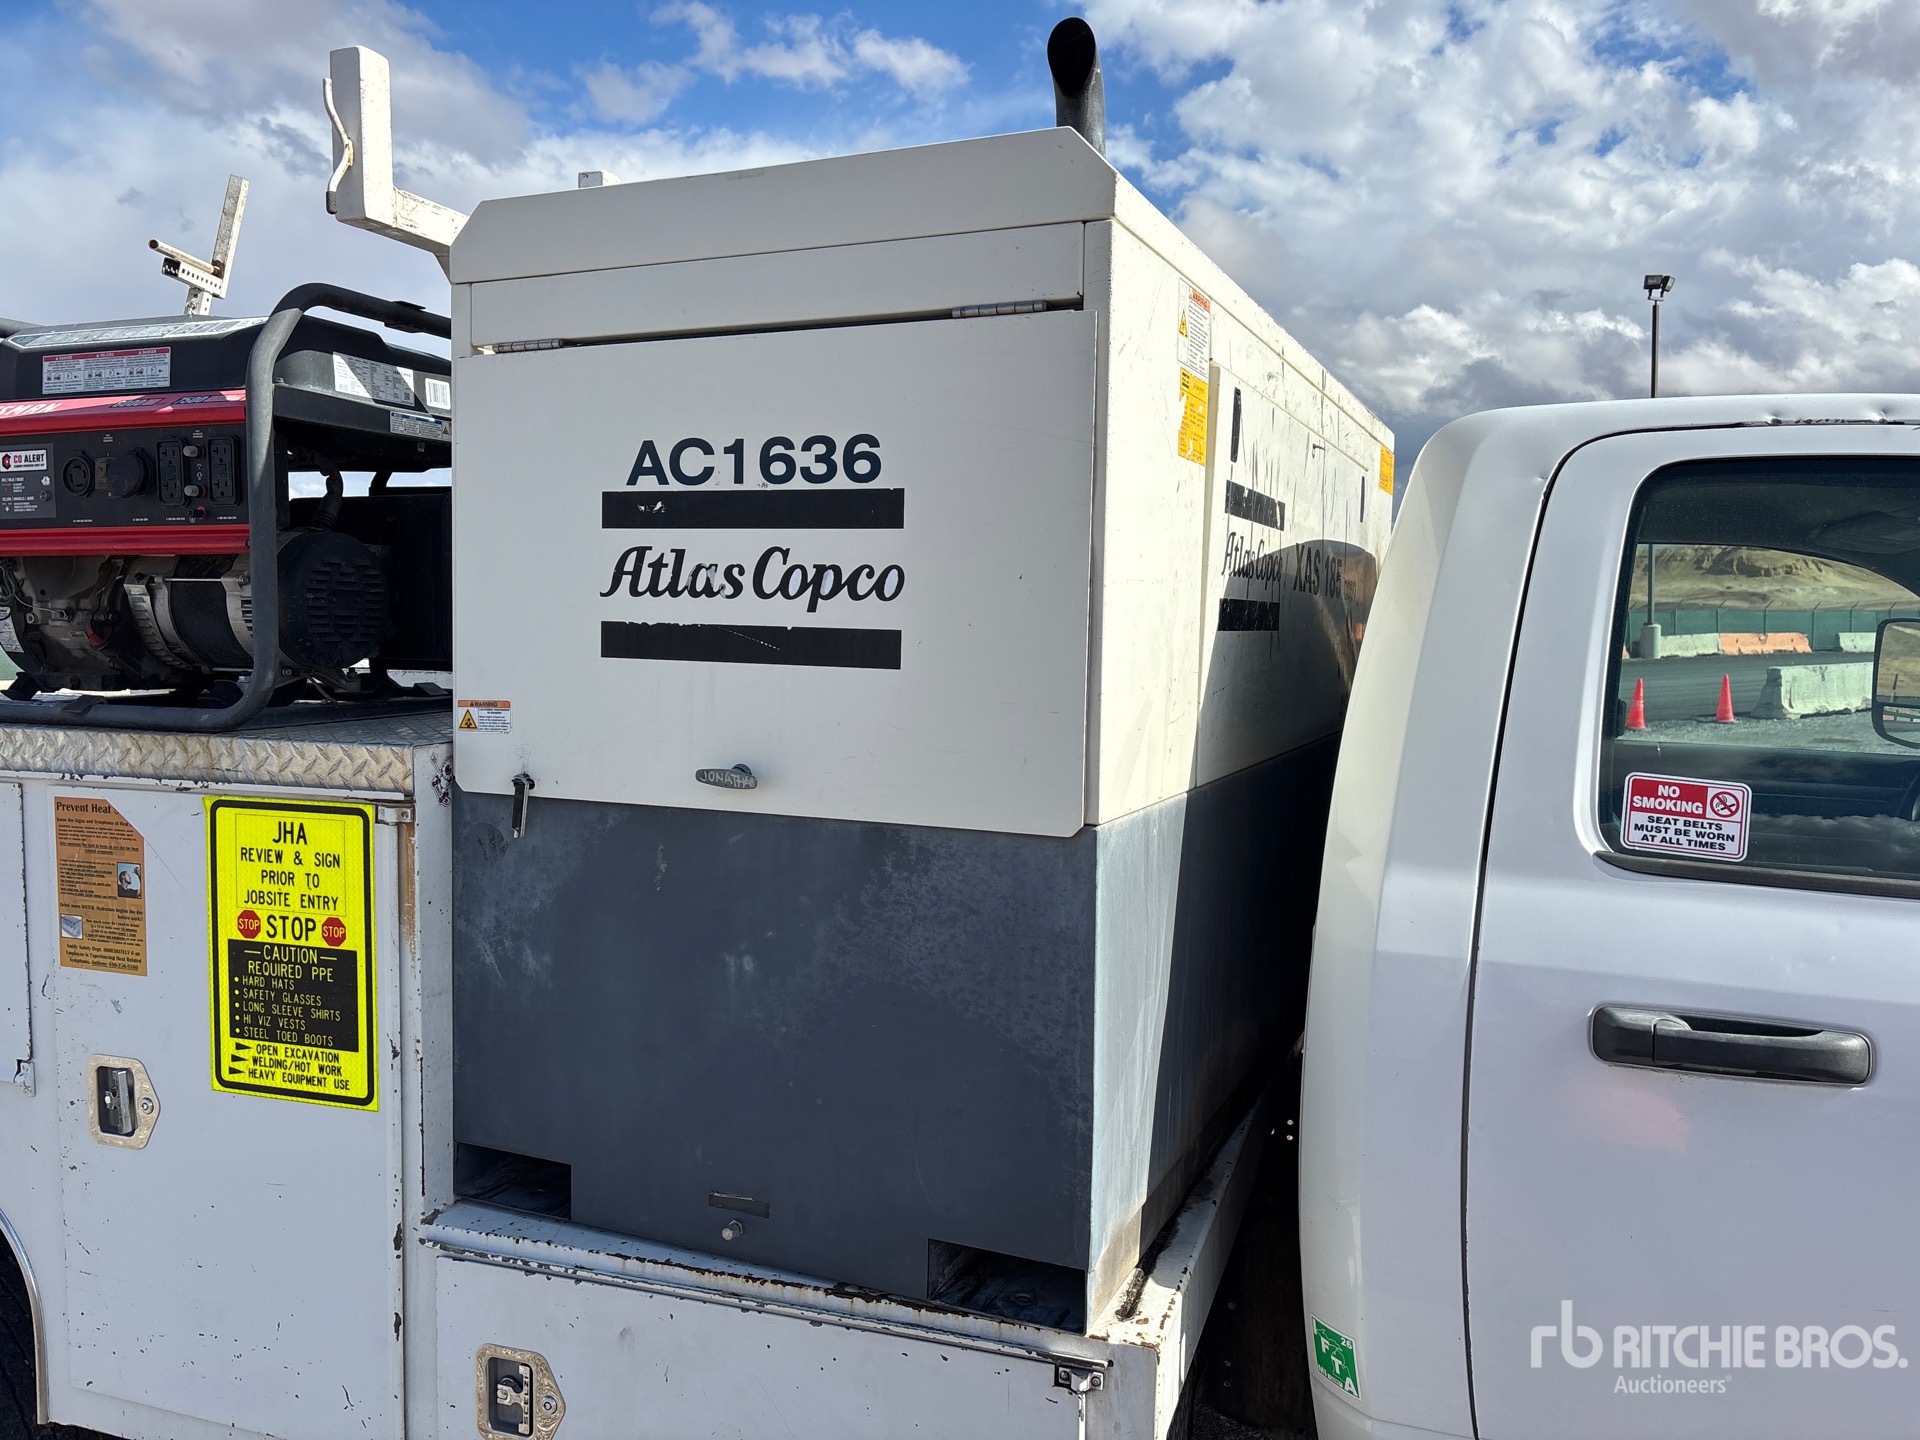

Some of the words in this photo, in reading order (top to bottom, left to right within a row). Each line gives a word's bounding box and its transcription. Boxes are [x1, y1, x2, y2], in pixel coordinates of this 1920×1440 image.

[14, 454, 22, 463] CO
[24, 454, 44, 463] ALERT
[626, 434, 882, 486] AC1636
[1221, 532, 1256, 580] Atlas
[600, 546, 744, 600] Atlas
[752, 546, 905, 612] Copco
[1292, 542, 1321, 596] XAS
[1324, 555, 1342, 598] 185
[1658, 784, 1680, 798] NO
[56, 802, 88, 812] Prevent
[92, 803, 111, 814] Heat
[1632, 796, 1703, 814] SMOKING
[1647, 815, 1679, 826] SEAT
[1683, 820, 1722, 831] BELTS
[272, 821, 308, 845] JHA
[1634, 824, 1670, 834] MUST
[1674, 827, 1691, 837] BE
[1695, 830, 1735, 842] WORN
[1641, 834, 1656, 843] AT
[1660, 836, 1683, 846] ALL
[1686, 839, 1726, 851] TIMES
[240, 847, 283, 864] REVIEW
[294, 851, 304, 866] &
[314, 852, 340, 868] SIGN
[261, 870, 295, 886] PRIOR
[305, 873, 320, 888] TO
[244, 890, 290, 907] JOBSITE
[300, 894, 338, 911] ENTRY
[239, 918, 260, 930] STOP
[266, 915, 317, 941] STOP
[322, 926, 345, 938] STOP
[263, 945, 318, 964] CAUTION
[248, 961, 302, 978] REQUIRED
[312, 967, 334, 982] PPE
[243, 975, 265, 987] HARD
[272, 978, 294, 990] HATS
[243, 988, 275, 1001] SAFETY
[282, 992, 322, 1006] GLASSES
[243, 1002, 265, 1013] LONG
[272, 1004, 304, 1017] SLEEVE
[311, 1008, 341, 1022] SHIRTS
[243, 1014, 252, 1025] HI
[258, 1015, 271, 1026] VIZ
[278, 1018, 306, 1031] VESTS
[244, 1027, 269, 1040] STEEL
[276, 1030, 298, 1042] TOED
[304, 1034, 334, 1046] BOOTS
[256, 1044, 278, 1056] OPEN
[284, 1047, 339, 1063] EXCAVATION
[252, 1056, 311, 1073] WELDING/HOT
[318, 1065, 342, 1077] WORK
[248, 1068, 276, 1081] HEAVY
[282, 1073, 327, 1088] EQUIPMENT
[334, 1079, 350, 1090] USE
[1340, 1338, 1352, 1350] 26
